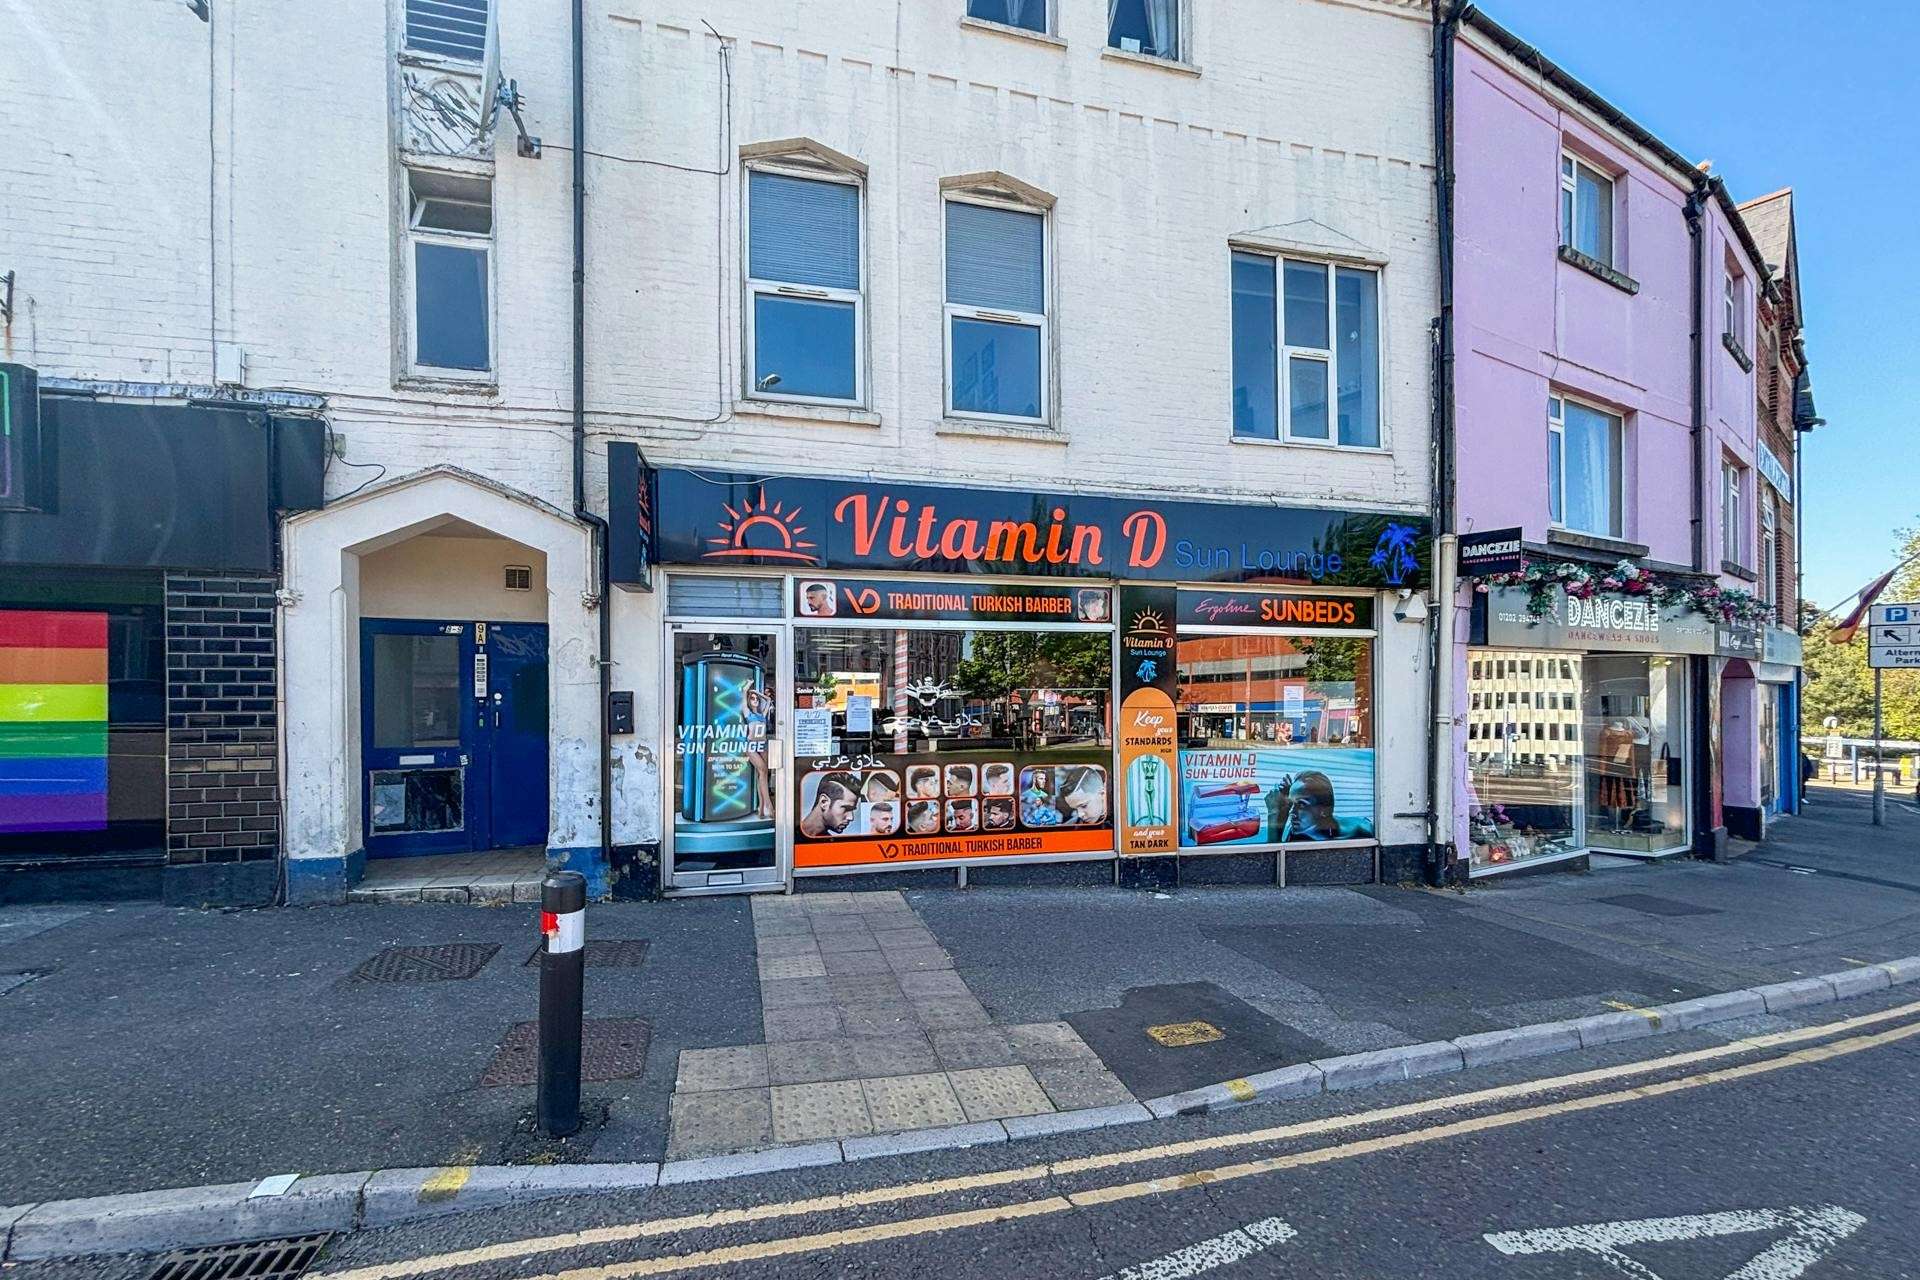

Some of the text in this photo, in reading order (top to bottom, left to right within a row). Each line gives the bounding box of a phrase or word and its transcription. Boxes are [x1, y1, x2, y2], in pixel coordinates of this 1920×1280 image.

[834, 493, 1342, 574] Vitamin D Sun Lounge
[1462, 540, 1520, 558] DANCEZIE
[888, 592, 968, 612] TRADITIONAL
[971, 594, 1022, 613] TURKISH
[1026, 597, 1072, 615] BARBER
[1260, 598, 1355, 624] SUNBEDS
[1123, 636, 1174, 649] Vitamin D
[1130, 648, 1167, 657] Sun Lounge
[1133, 710, 1164, 728] Keep
[678, 724, 765, 739] VITAMIN D
[1154, 727, 1173, 737] your
[676, 741, 765, 754] SUN LOUNGE
[1125, 737, 1172, 746] STANDARDS
[812, 753, 885, 771] حلاق عربي
[1185, 753, 1256, 767] VITAMIN D
[1186, 767, 1256, 779] SUN LOUNGE
[1133, 828, 1149, 836] and
[902, 841, 963, 856] TRADITIONAL
[966, 839, 1005, 853] TURKISH
[1007, 837, 1043, 850] BARBER
[1130, 839, 1169, 848] TAN DARK
